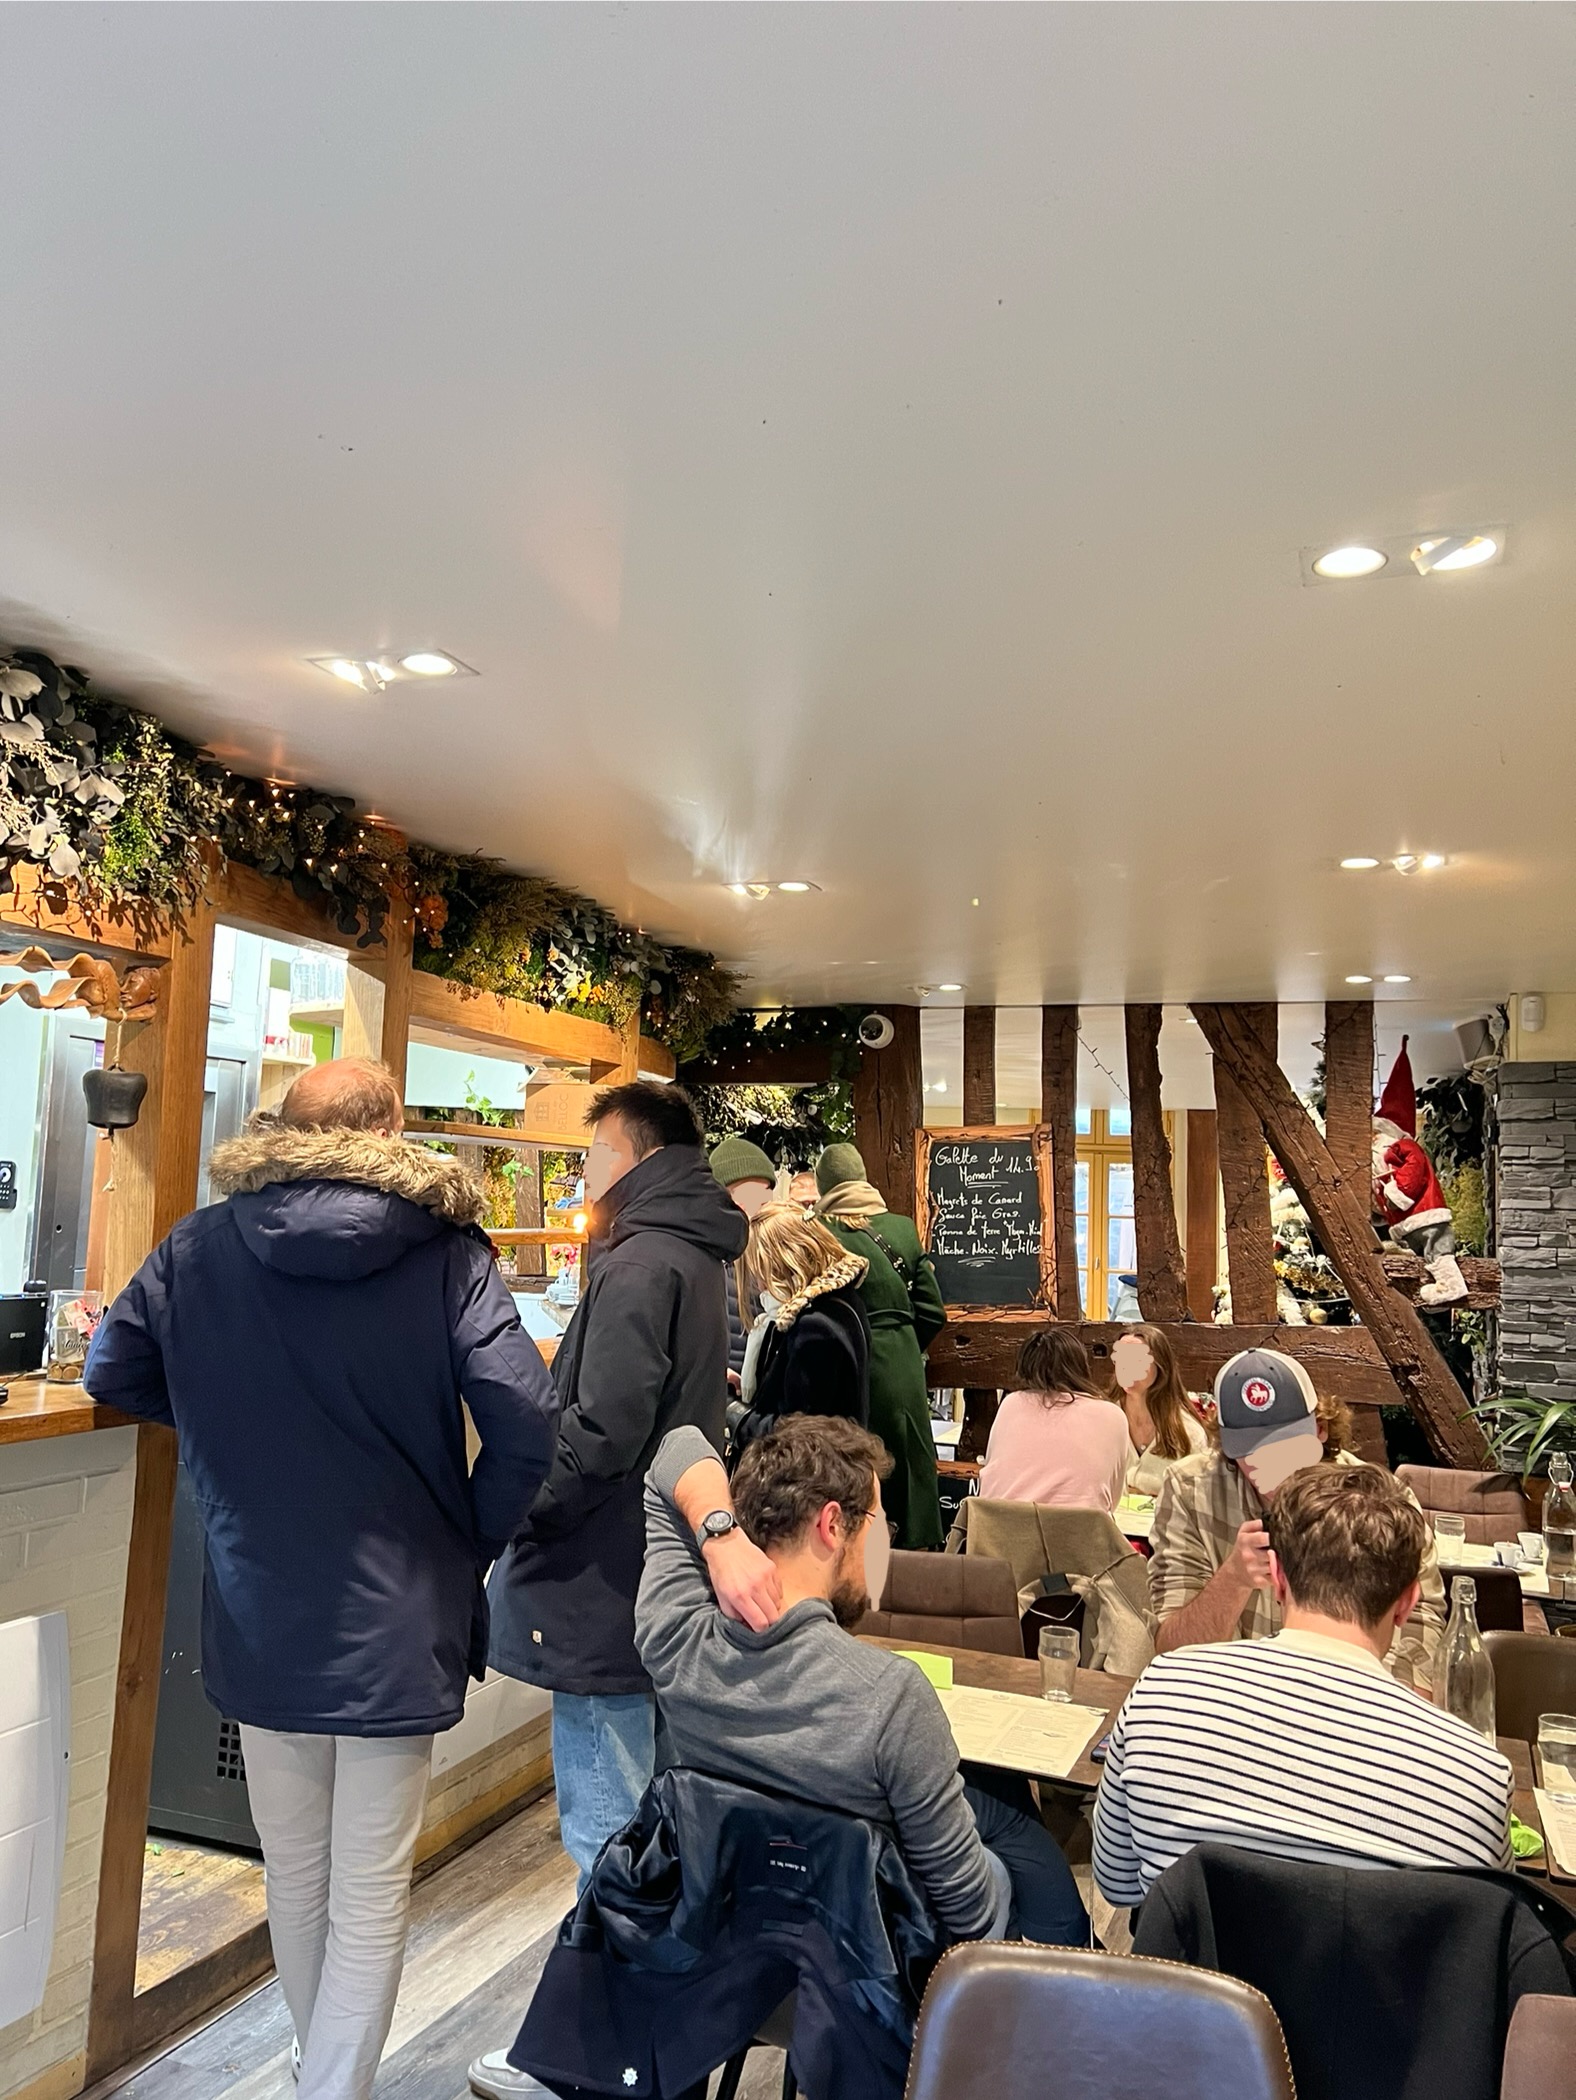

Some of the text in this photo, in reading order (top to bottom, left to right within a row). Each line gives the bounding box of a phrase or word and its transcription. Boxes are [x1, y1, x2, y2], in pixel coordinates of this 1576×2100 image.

[935, 1146, 1004, 1166] Galette du
[959, 1165, 999, 1186] Moment
[971, 1193, 983, 1205] de
[988, 1191, 1022, 1205] Canard
[966, 1225, 977, 1236] de
